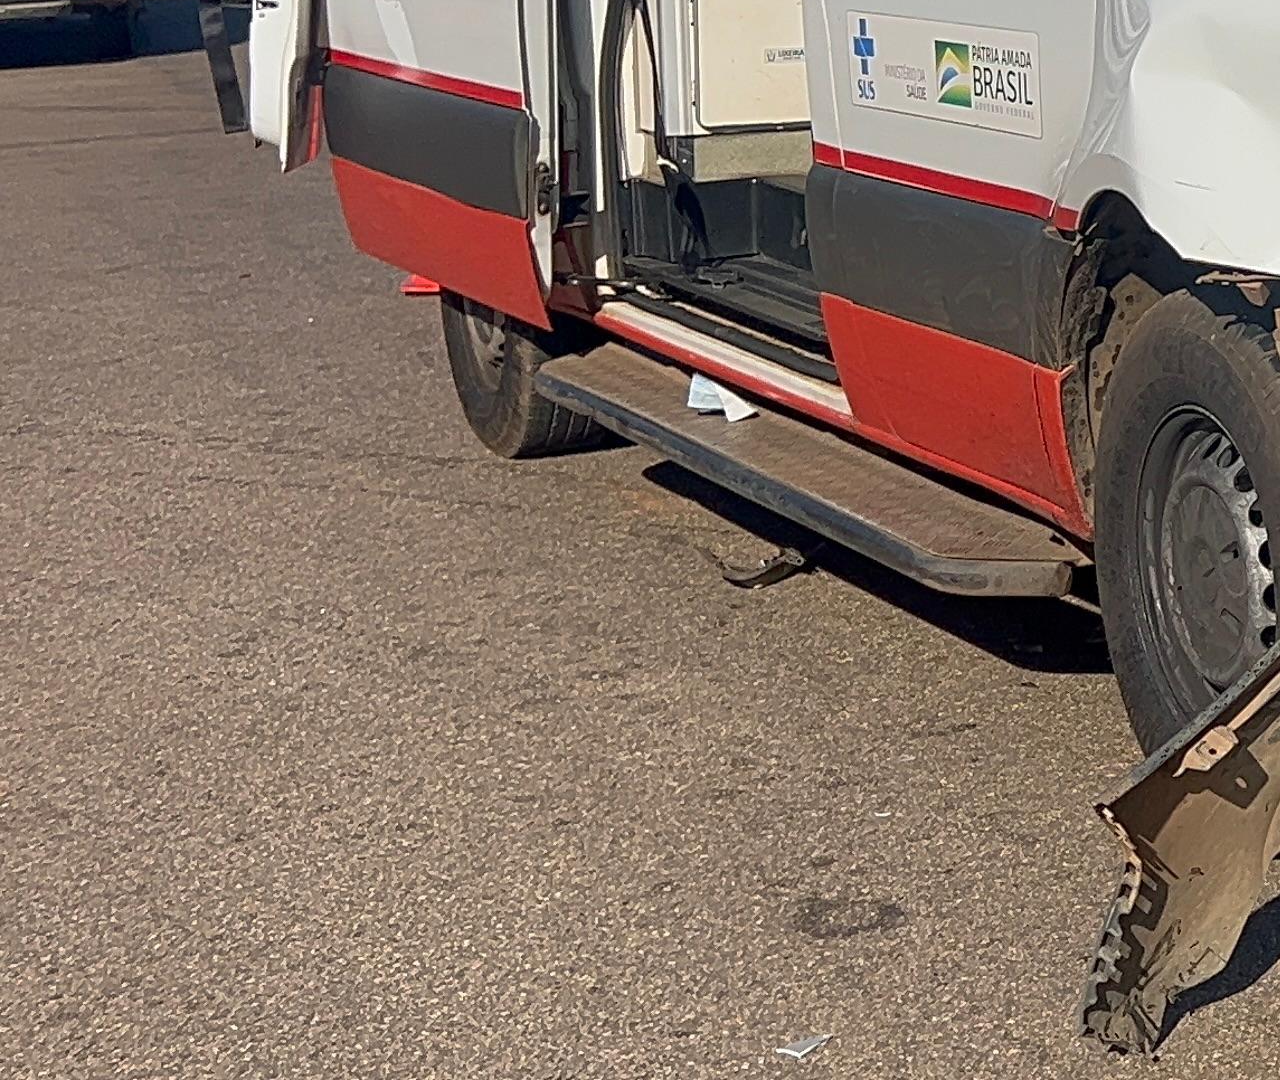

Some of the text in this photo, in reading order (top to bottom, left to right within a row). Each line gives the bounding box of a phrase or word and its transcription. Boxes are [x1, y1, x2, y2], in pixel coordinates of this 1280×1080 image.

[1001, 49, 1032, 70] AMADA
[857, 78, 876, 101] SUS
[973, 65, 1033, 106] BRASIL
